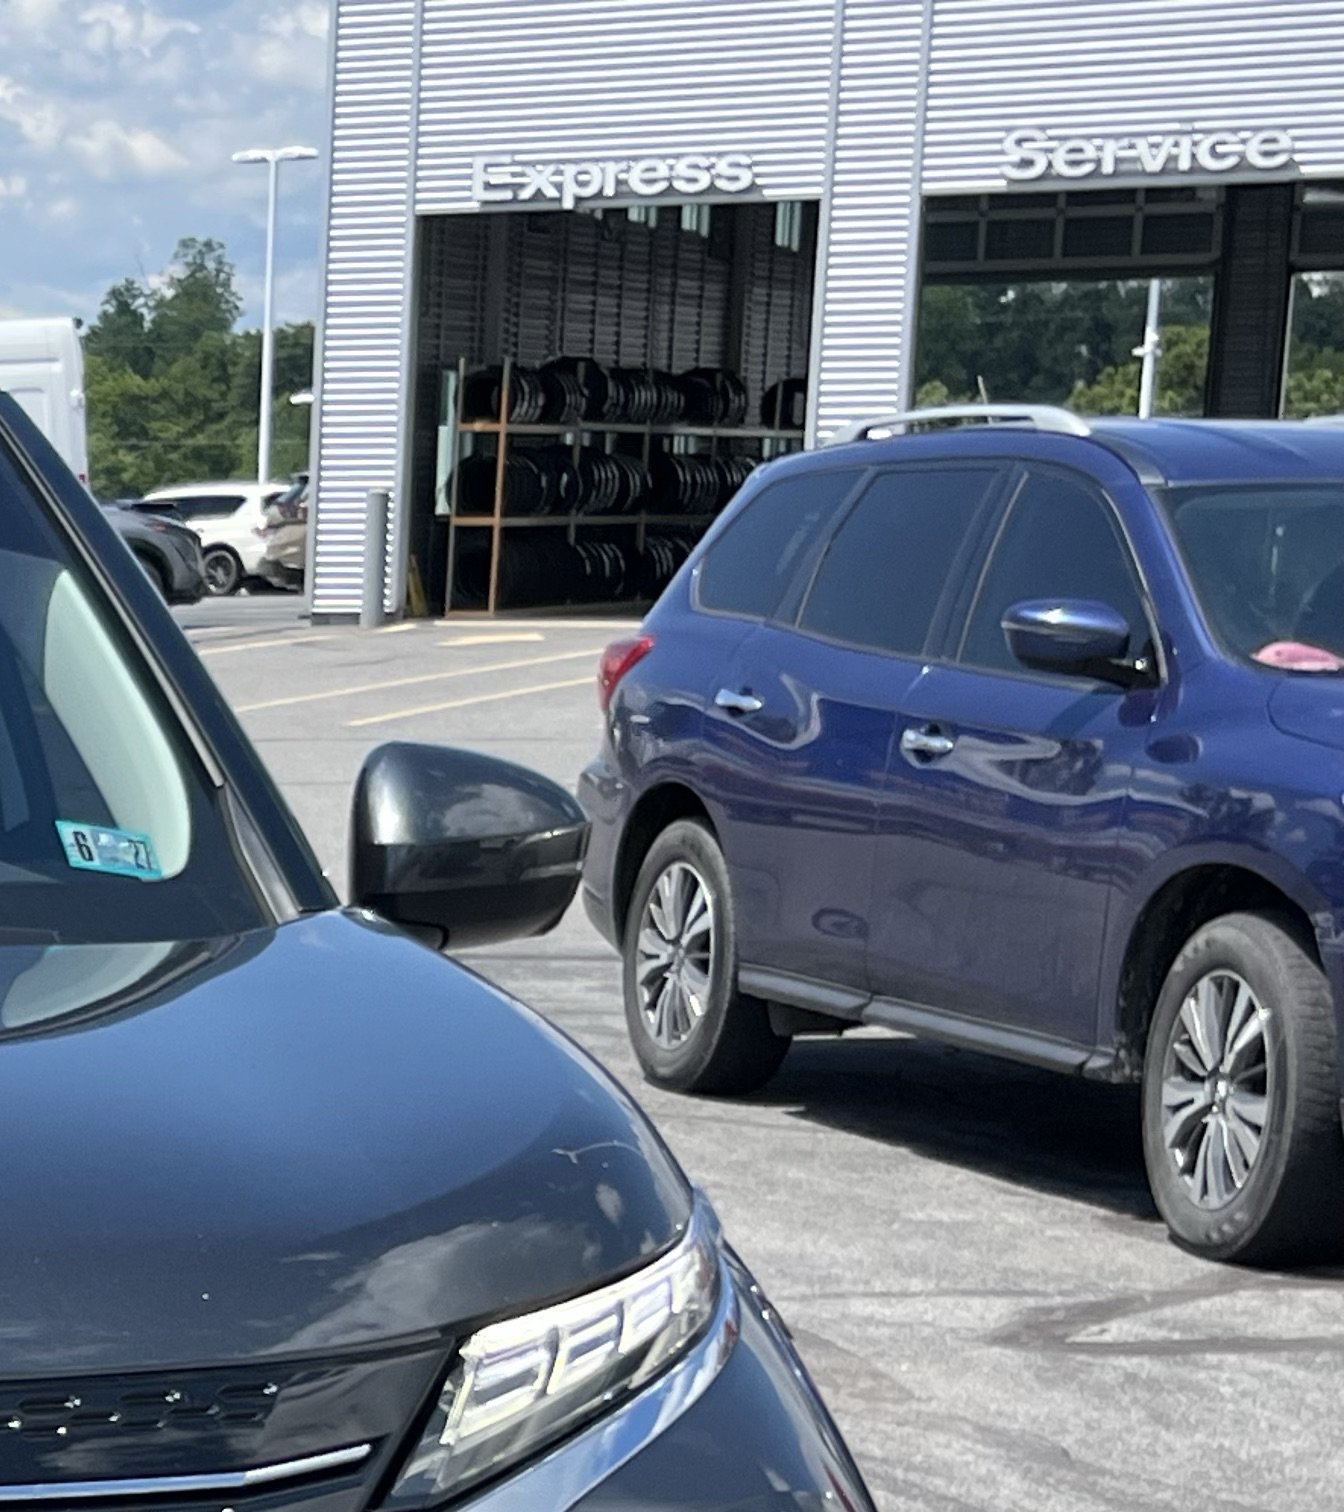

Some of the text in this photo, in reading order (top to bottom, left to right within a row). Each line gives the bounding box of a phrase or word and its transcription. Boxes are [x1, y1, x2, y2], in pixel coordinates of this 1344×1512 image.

[1000, 123, 1294, 180] Service
[472, 153, 754, 209] Express
[72, 830, 94, 862] 6
